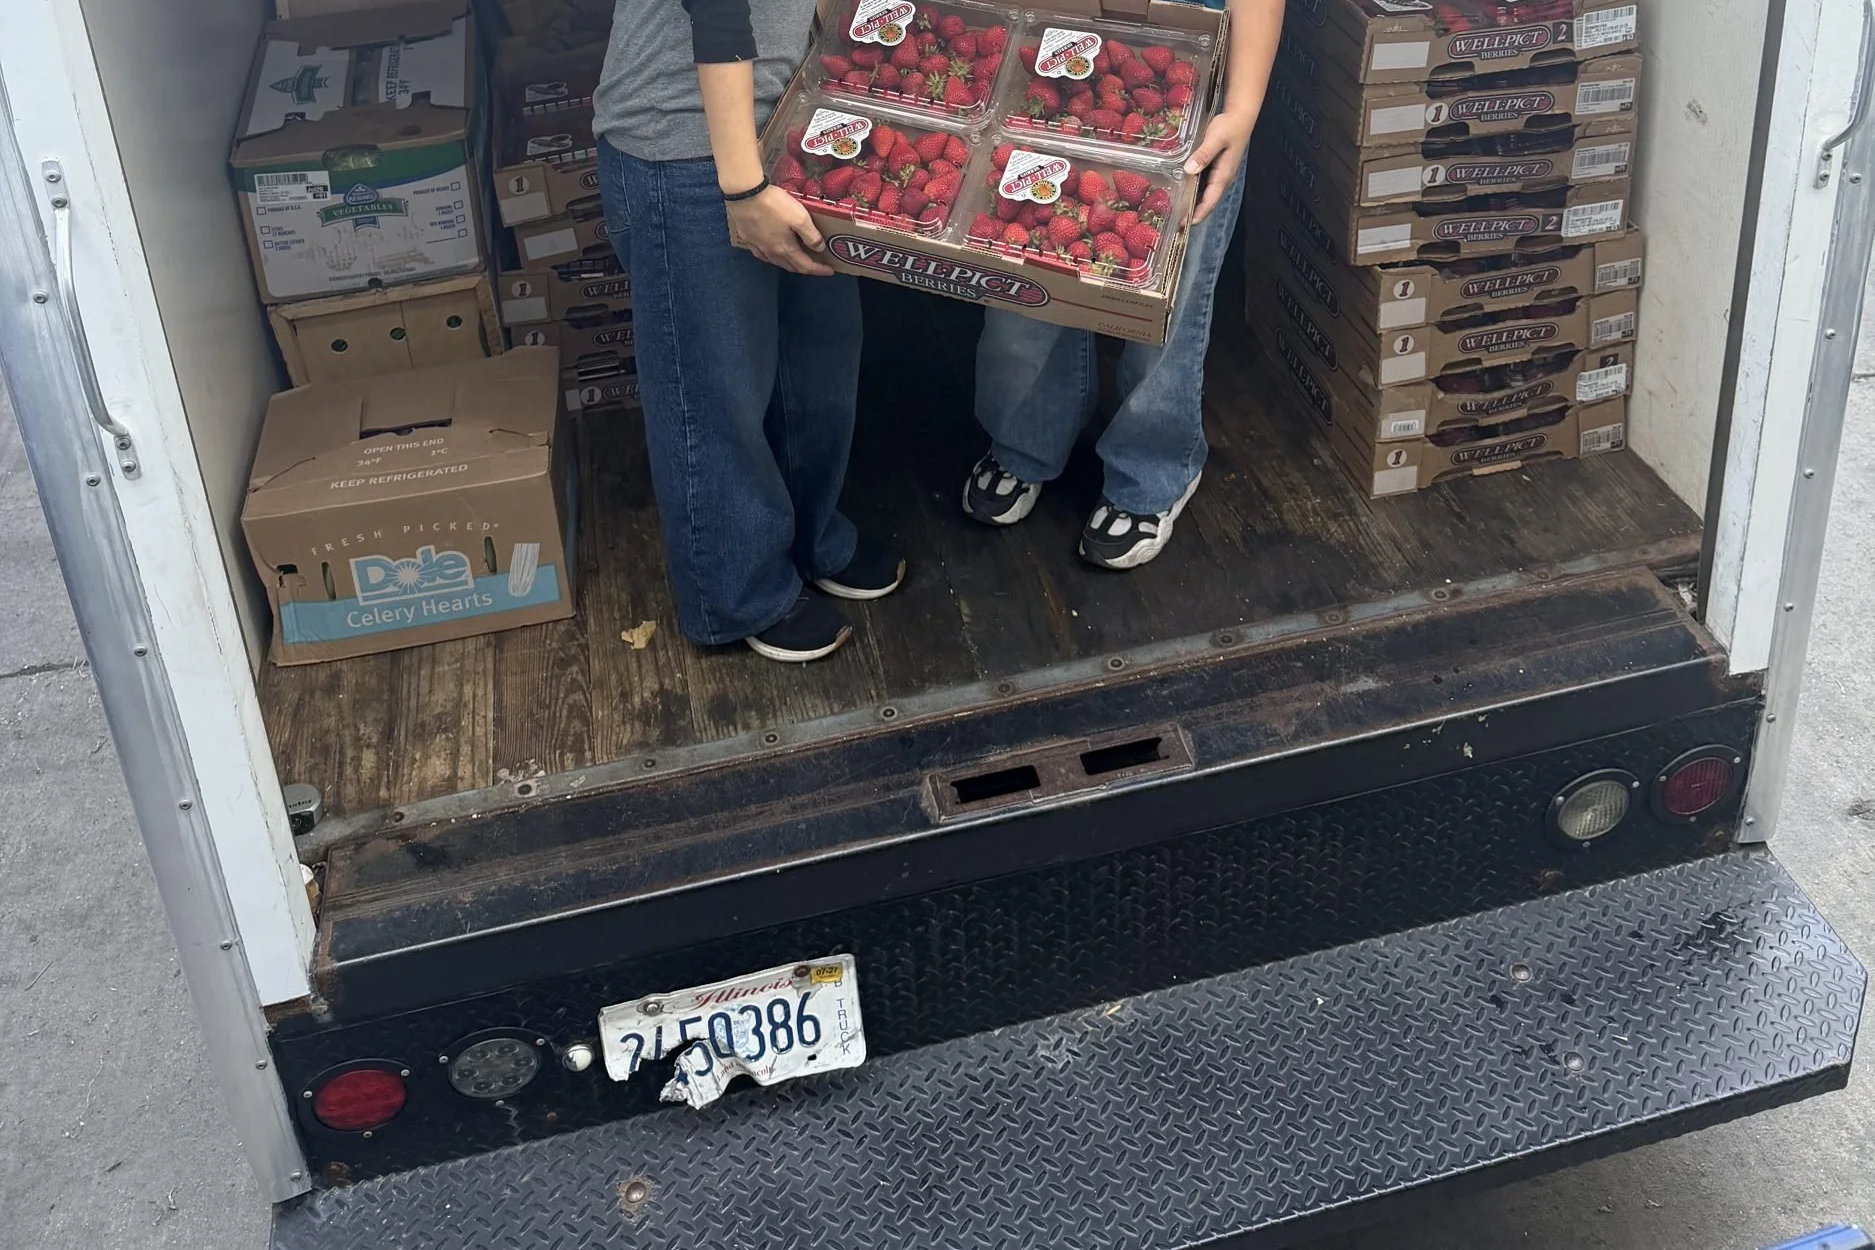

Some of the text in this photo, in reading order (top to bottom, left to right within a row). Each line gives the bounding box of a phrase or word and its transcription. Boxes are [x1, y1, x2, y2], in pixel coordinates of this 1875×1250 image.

[1557, 23, 1568, 42] 2
[1481, 49, 1519, 60] BERRIES
[1433, 105, 1442, 122] 1
[1481, 112, 1519, 121] BERRIES
[1429, 167, 1439, 184] 1
[515, 176, 524, 192] 1
[333, 204, 393, 216] VEGETABLES
[1545, 216, 1558, 230] 2
[519, 283, 527, 297] 1
[901, 272, 977, 299] BERRIES
[1399, 281, 1409, 297] 1
[1492, 286, 1529, 297] BERRIES
[531, 332, 539, 345] 1
[1399, 336, 1409, 352] 1
[1490, 341, 1527, 352] BERRIES
[364, 437, 445, 456] OPEN THIS END
[1393, 451, 1403, 466] 1
[330, 463, 468, 490] KEEP REFRIGERATED
[311, 530, 383, 556] FRESH
[353, 547, 471, 593] Dole
[346, 592, 493, 628] Celery Hearts
[816, 966, 838, 976] 07-27
[691, 975, 794, 1010] Illinois
[836, 997, 851, 1055] TRUCK
